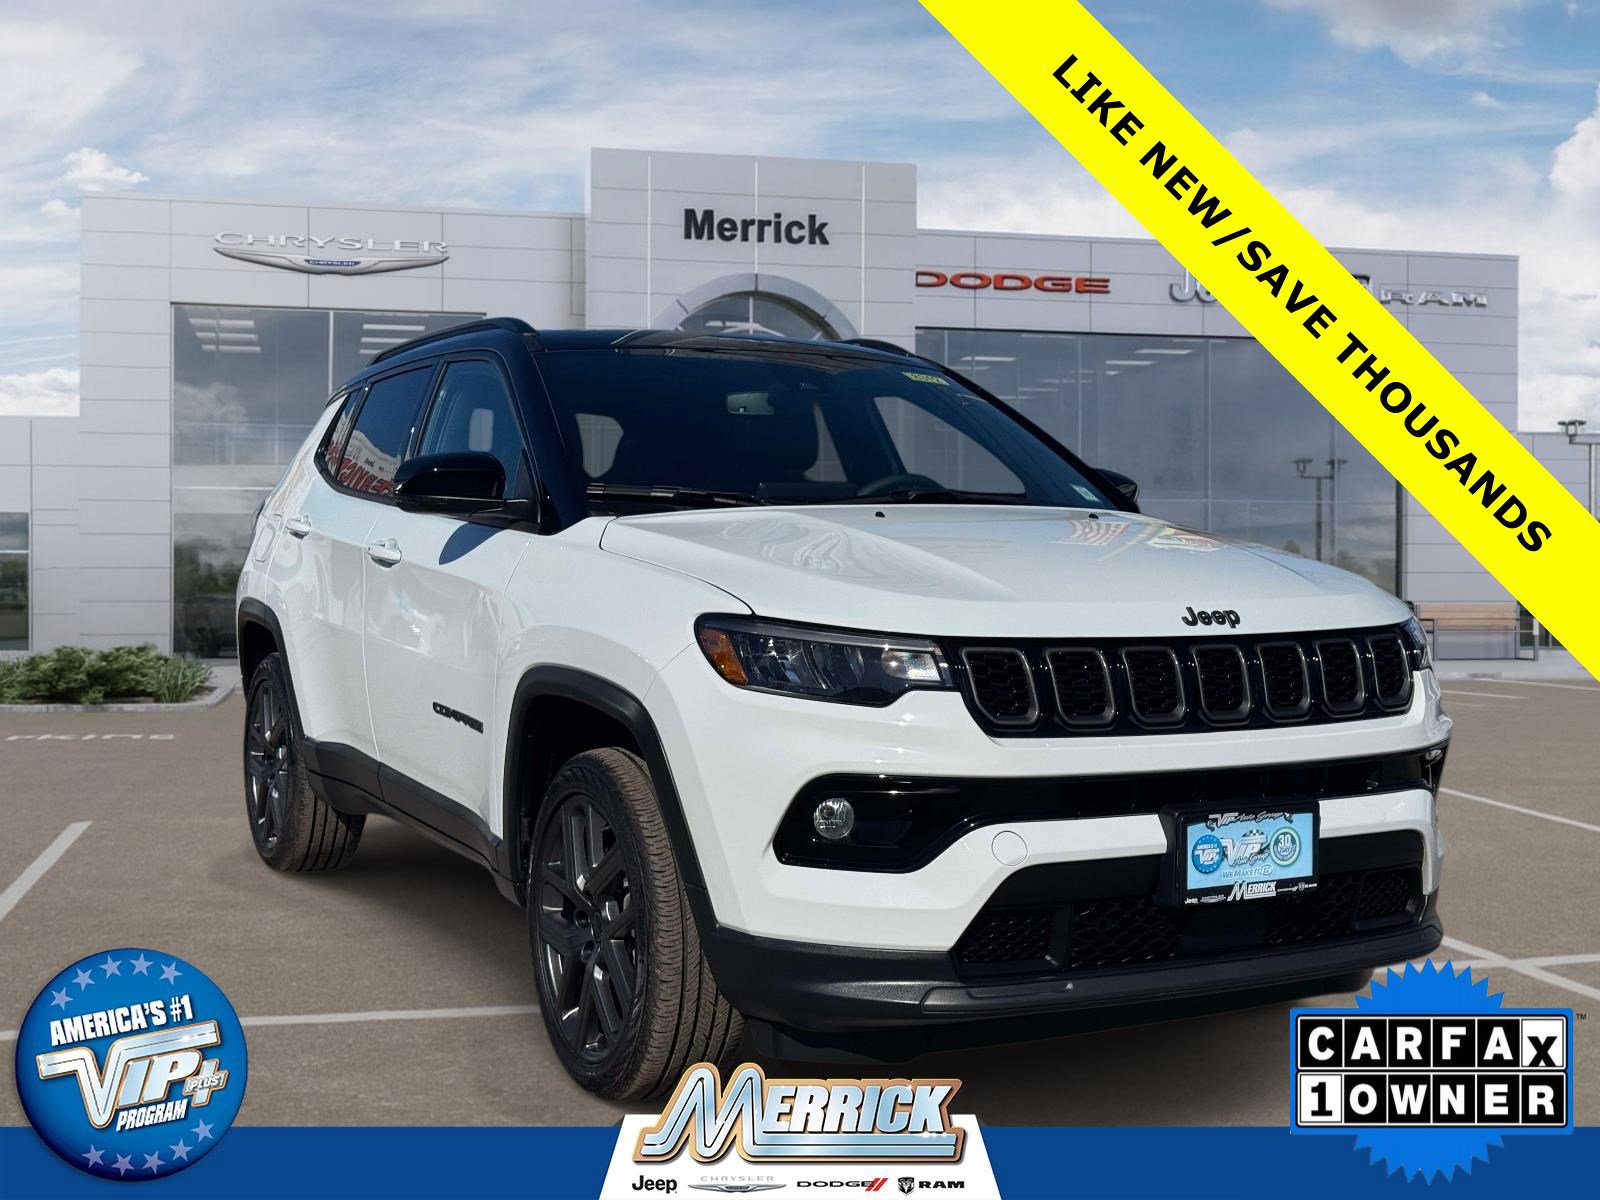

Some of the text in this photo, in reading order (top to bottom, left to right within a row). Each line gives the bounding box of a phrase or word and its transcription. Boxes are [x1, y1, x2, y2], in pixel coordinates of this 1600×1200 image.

[684, 208, 830, 245] Merrick
[214, 232, 449, 253] CHRYSLER
[915, 271, 1111, 294] DODGE
[1181, 607, 1240, 628] Jeep
[1220, 834, 1268, 867] VIP
[1279, 834, 1292, 847] 30
